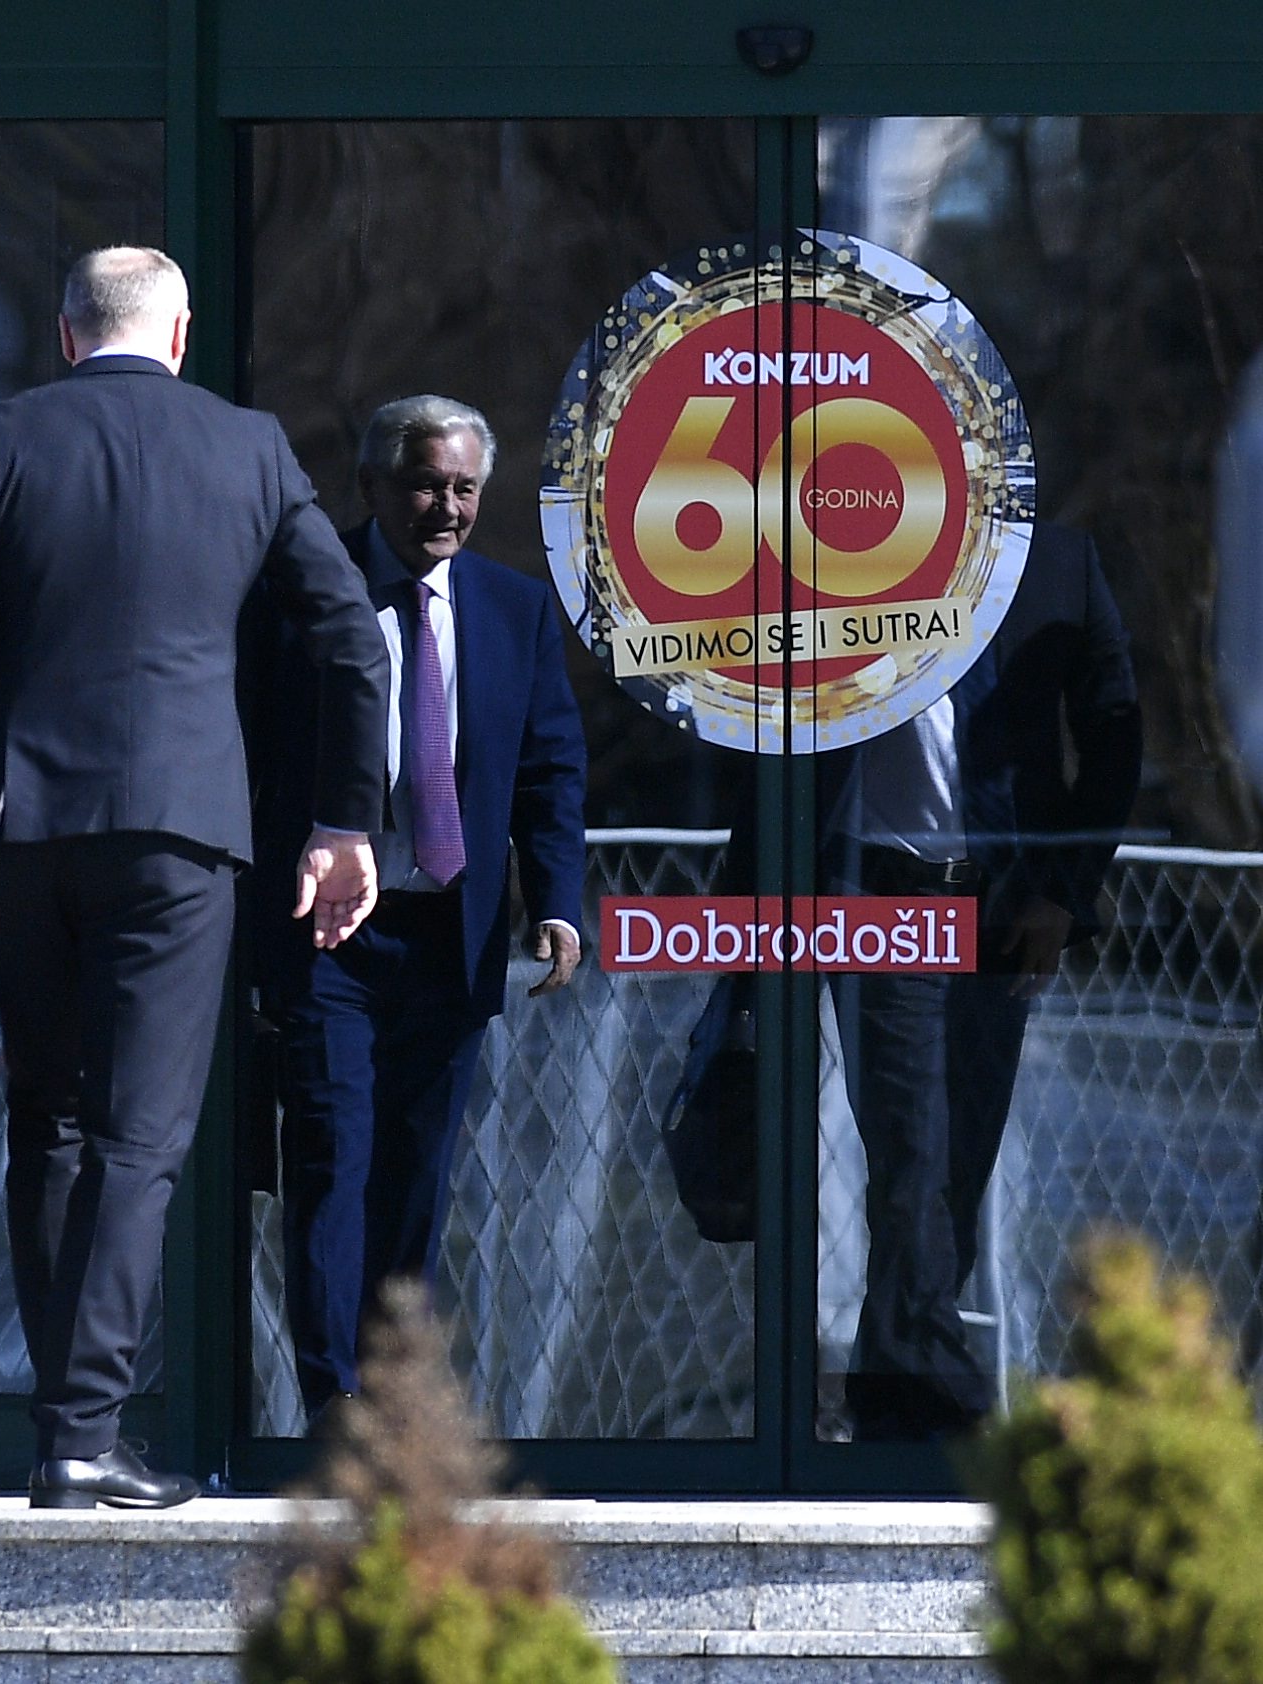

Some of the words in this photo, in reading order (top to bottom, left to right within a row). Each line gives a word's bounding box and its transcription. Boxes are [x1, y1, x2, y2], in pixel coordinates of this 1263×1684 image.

[704, 347, 869, 386] KONZUM
[634, 396, 947, 597] 60
[805, 488, 899, 510] GODINA
[626, 628, 755, 667] VIDIMO
[767, 622, 805, 653] SE
[819, 620, 827, 650] I
[841, 606, 961, 646] SUTRA!
[614, 908, 960, 965] Dobrodošli
